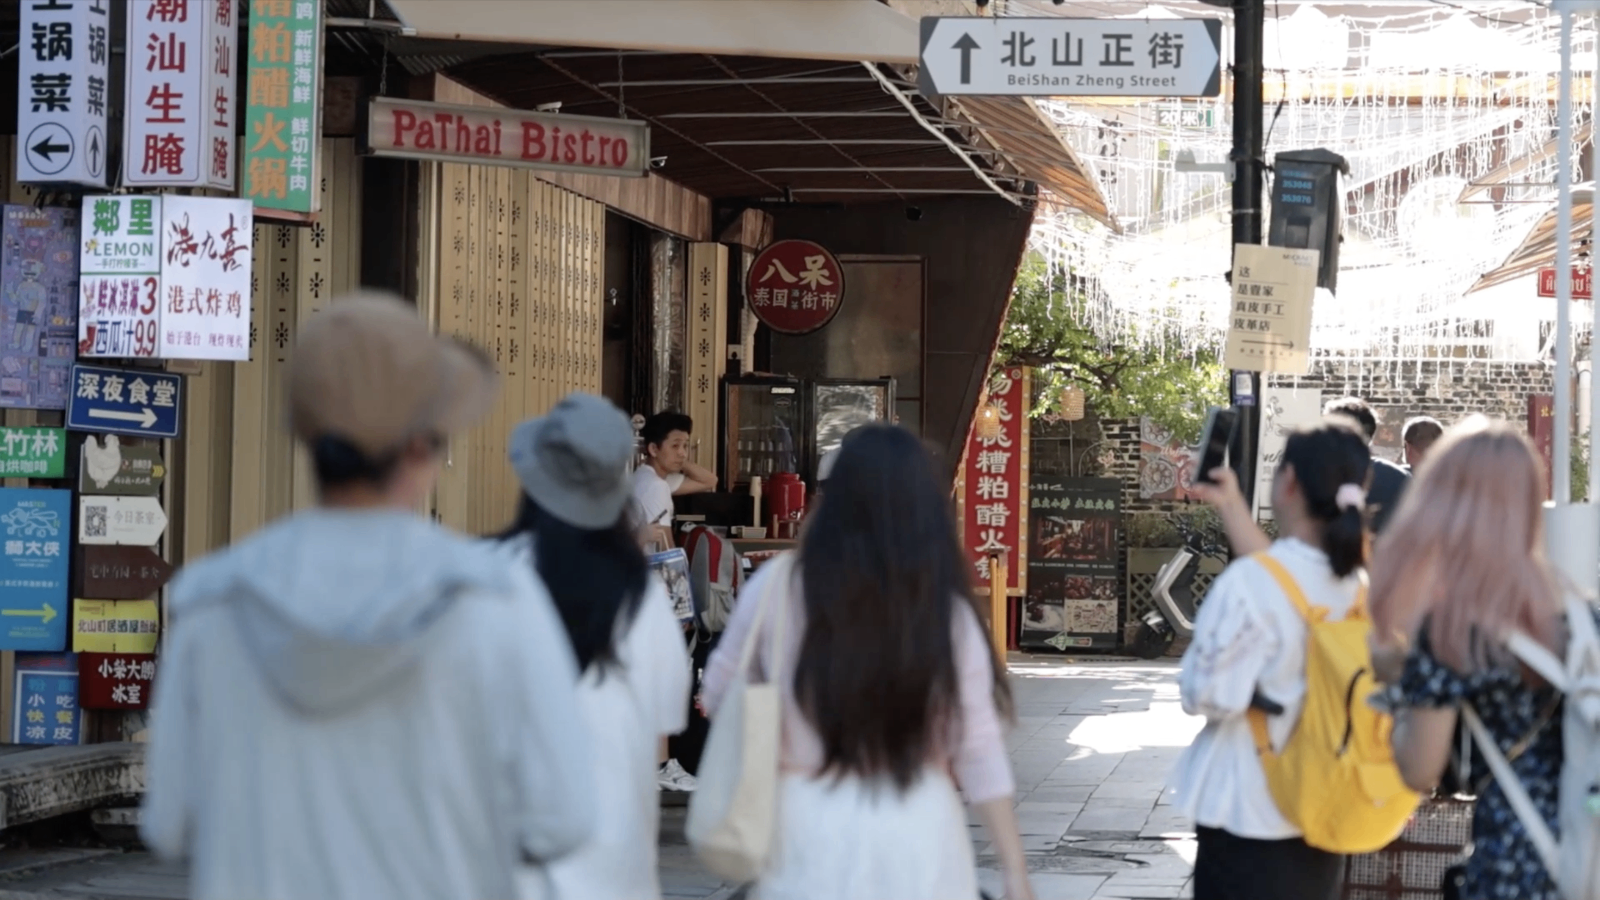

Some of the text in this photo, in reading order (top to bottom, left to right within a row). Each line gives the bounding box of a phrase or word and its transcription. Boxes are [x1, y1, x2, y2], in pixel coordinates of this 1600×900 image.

[1000, 31, 1184, 69] 北山正街
[142, 0, 187, 175] 潮汕生腌
[1007, 74, 1176, 89] BeiShan Zheng Street
[392, 110, 628, 167] PaThai Bistro
[94, 242, 154, 257] LEMON
[140, 276, 158, 316] 3
[168, 285, 242, 318] 港式炸鸡
[754, 287, 788, 308] 泰国
[801, 290, 837, 311] 街市
[95, 319, 134, 356] 西瓜汁
[76, 372, 176, 408] 深夜食堂
[0, 428, 59, 458] 竹林
[27, 693, 74, 708] 小吃
[111, 683, 141, 704] 冰室
